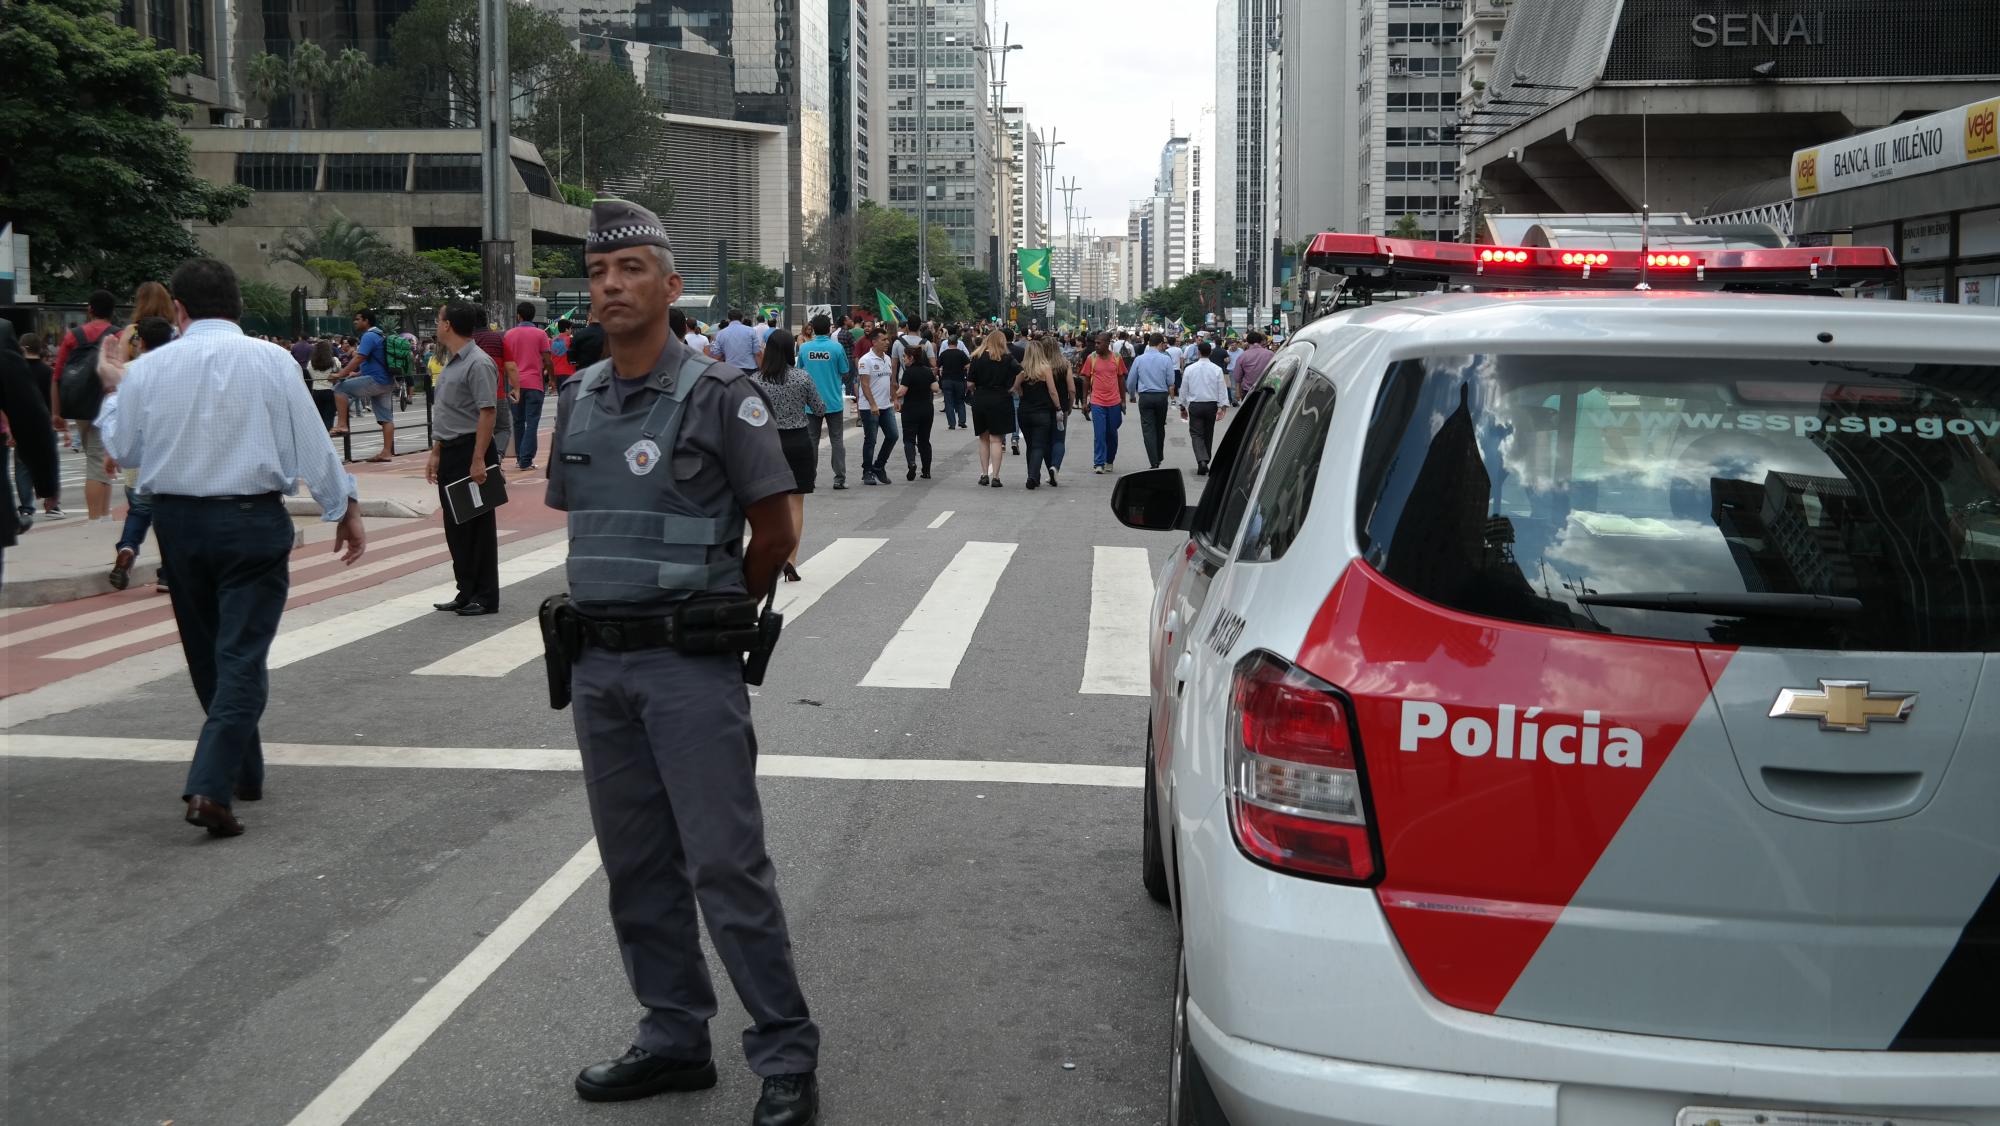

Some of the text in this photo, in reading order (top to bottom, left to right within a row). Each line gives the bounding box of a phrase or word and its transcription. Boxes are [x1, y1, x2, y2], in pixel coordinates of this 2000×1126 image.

[1691, 11, 1824, 47] SENAI
[1968, 106, 1994, 143] veja
[1797, 155, 1815, 183] veja
[1834, 146, 1870, 177] BANCA
[1875, 139, 1886, 168] III
[1892, 125, 1943, 164] MILÊNIO
[809, 351, 830, 360] BMG
[1400, 699, 1643, 768] Polícia
